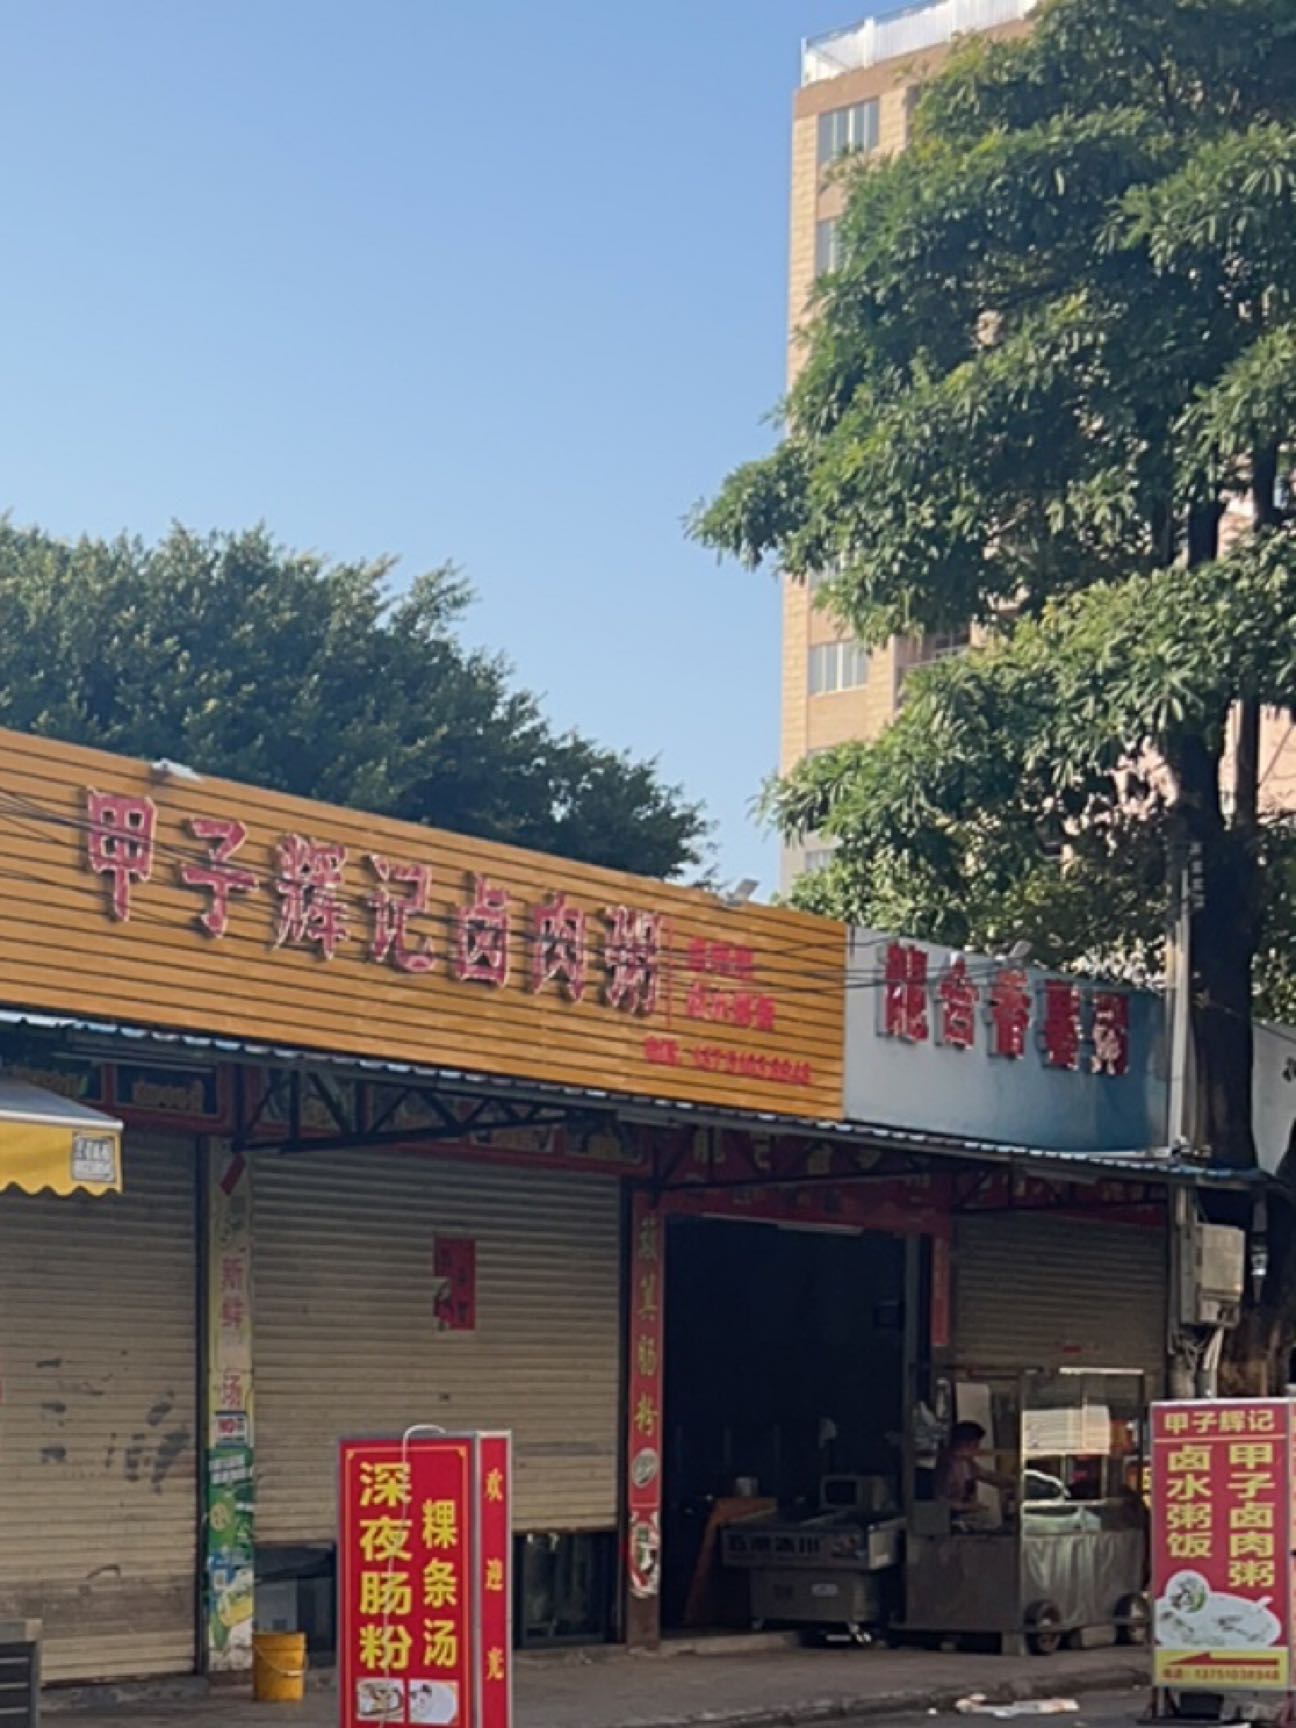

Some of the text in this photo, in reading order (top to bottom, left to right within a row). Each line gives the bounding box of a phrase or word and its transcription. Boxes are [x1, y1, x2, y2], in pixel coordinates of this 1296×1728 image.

[87, 787, 661, 1017] 甲子辉记卤肉粥
[1164, 1410, 1275, 1434] 甲子辉记
[359, 1462, 413, 1671] 深夜肠粉
[1166, 1444, 1212, 1558] 卤水粥饭
[1227, 1443, 1275, 1587] 甲子卤肉粥
[421, 1499, 457, 1668] 粿条汤
